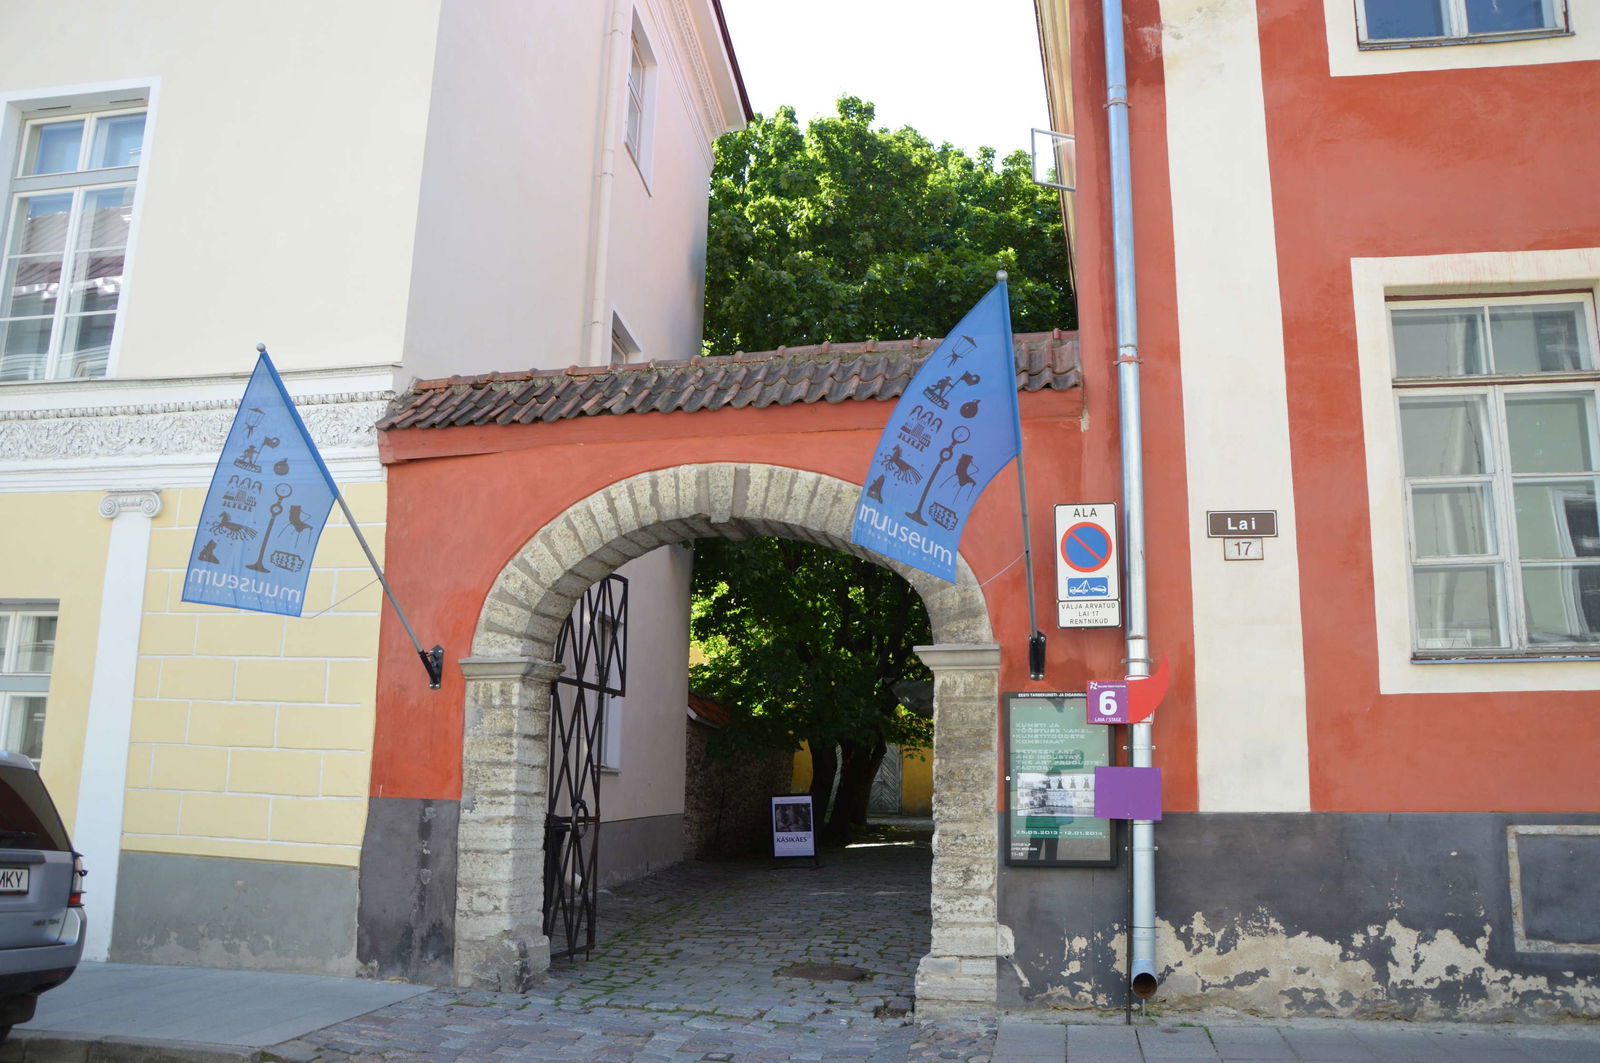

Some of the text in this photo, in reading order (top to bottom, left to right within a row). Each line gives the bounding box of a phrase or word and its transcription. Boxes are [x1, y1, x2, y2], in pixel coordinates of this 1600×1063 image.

[1073, 507, 1097, 518] ALA
[1227, 517, 1256, 530] Lai
[859, 503, 953, 566] muuseum
[1234, 541, 1252, 556] 17
[1099, 690, 1118, 716] 6
